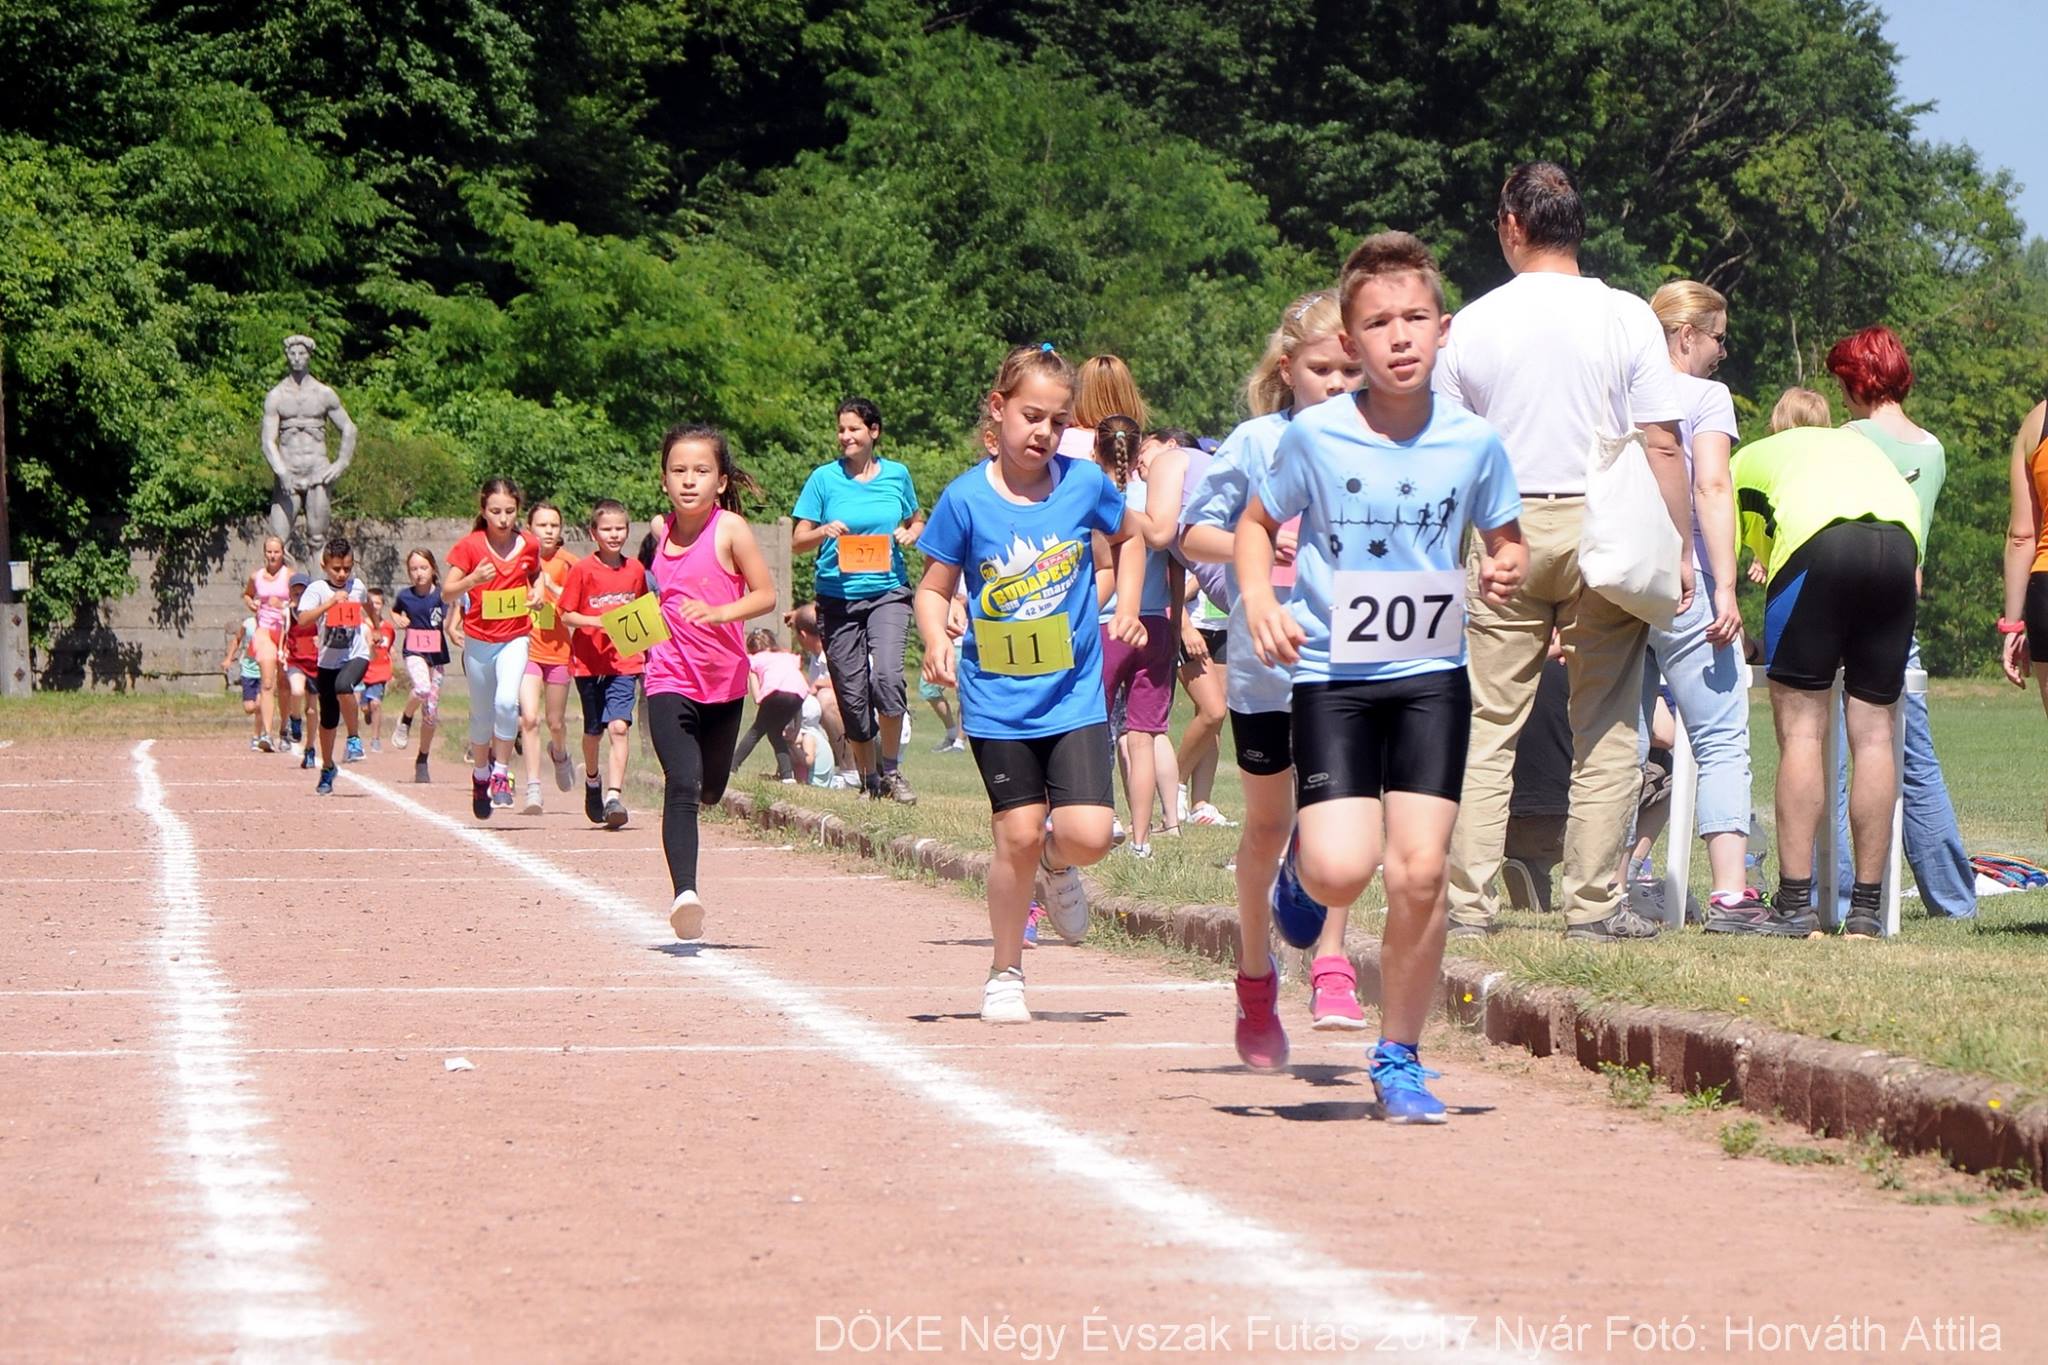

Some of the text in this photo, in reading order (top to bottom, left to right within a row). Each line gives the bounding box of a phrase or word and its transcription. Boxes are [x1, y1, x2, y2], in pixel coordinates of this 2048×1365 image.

[855, 547, 875, 563] 27
[497, 595, 518, 613] 14
[1025, 602, 1052, 616] 42 km
[338, 606, 354, 621] 14
[1346, 593, 1454, 642] 207
[618, 610, 650, 643] 12
[416, 635, 431, 648] 13
[1003, 632, 1045, 665] 11
